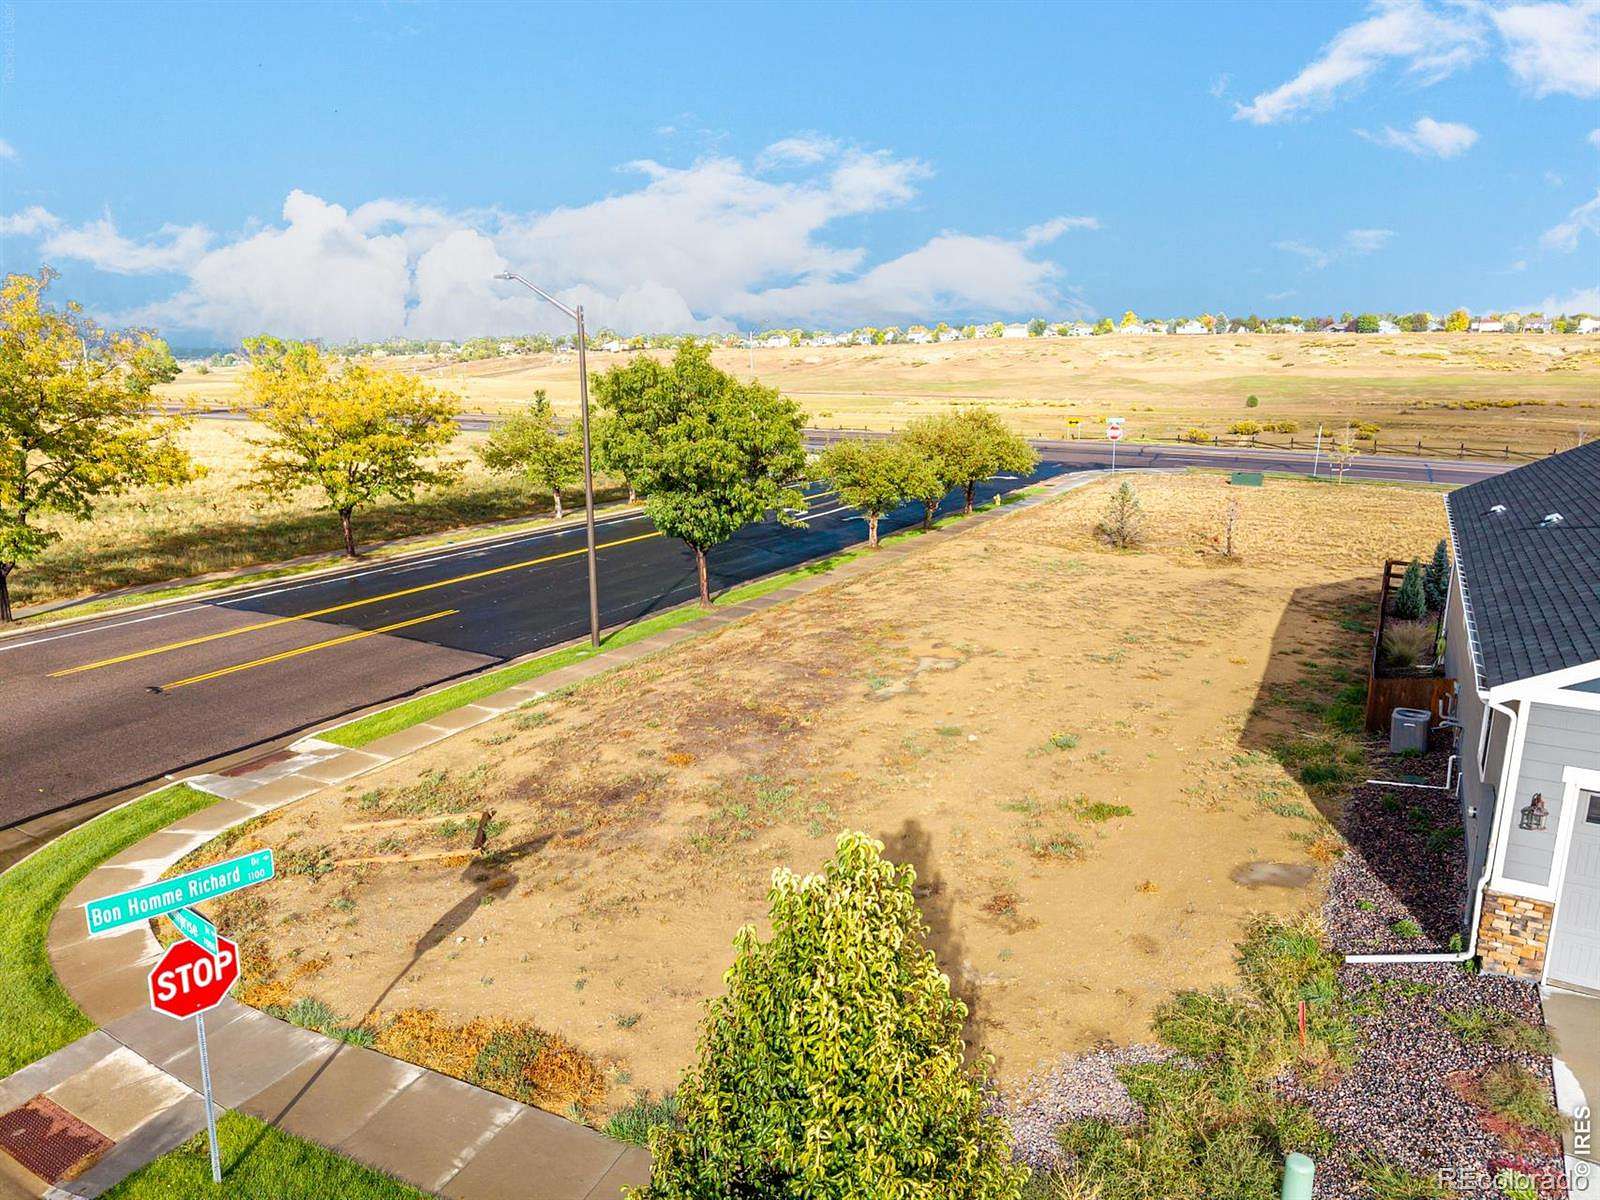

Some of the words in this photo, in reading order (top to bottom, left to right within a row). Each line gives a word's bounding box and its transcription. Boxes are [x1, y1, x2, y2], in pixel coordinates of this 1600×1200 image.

[91, 906, 122, 928] Bon
[127, 888, 184, 917] Homme
[188, 866, 241, 897] Richard
[248, 868, 265, 882] 1100
[157, 950, 233, 1002] STOP
